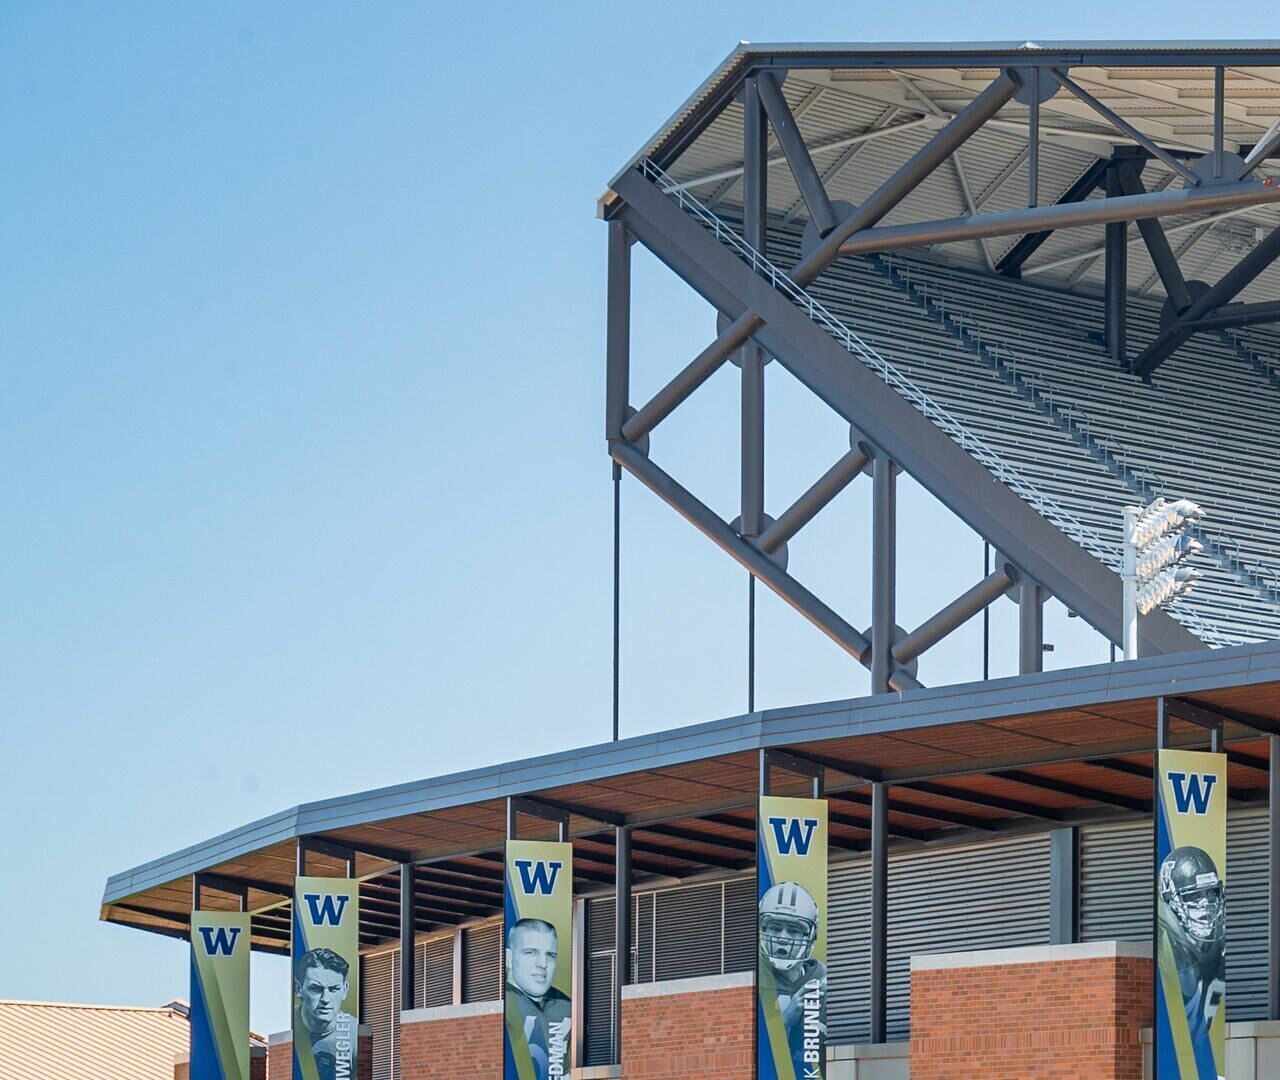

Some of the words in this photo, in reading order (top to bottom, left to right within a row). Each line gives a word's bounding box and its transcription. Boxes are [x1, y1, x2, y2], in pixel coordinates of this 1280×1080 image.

[1167, 771, 1217, 815] W
[768, 817, 818, 855] W
[514, 860, 562, 895] W
[305, 893, 350, 927] W
[199, 927, 241, 957] W
[804, 978, 820, 1063] BRUNELL
